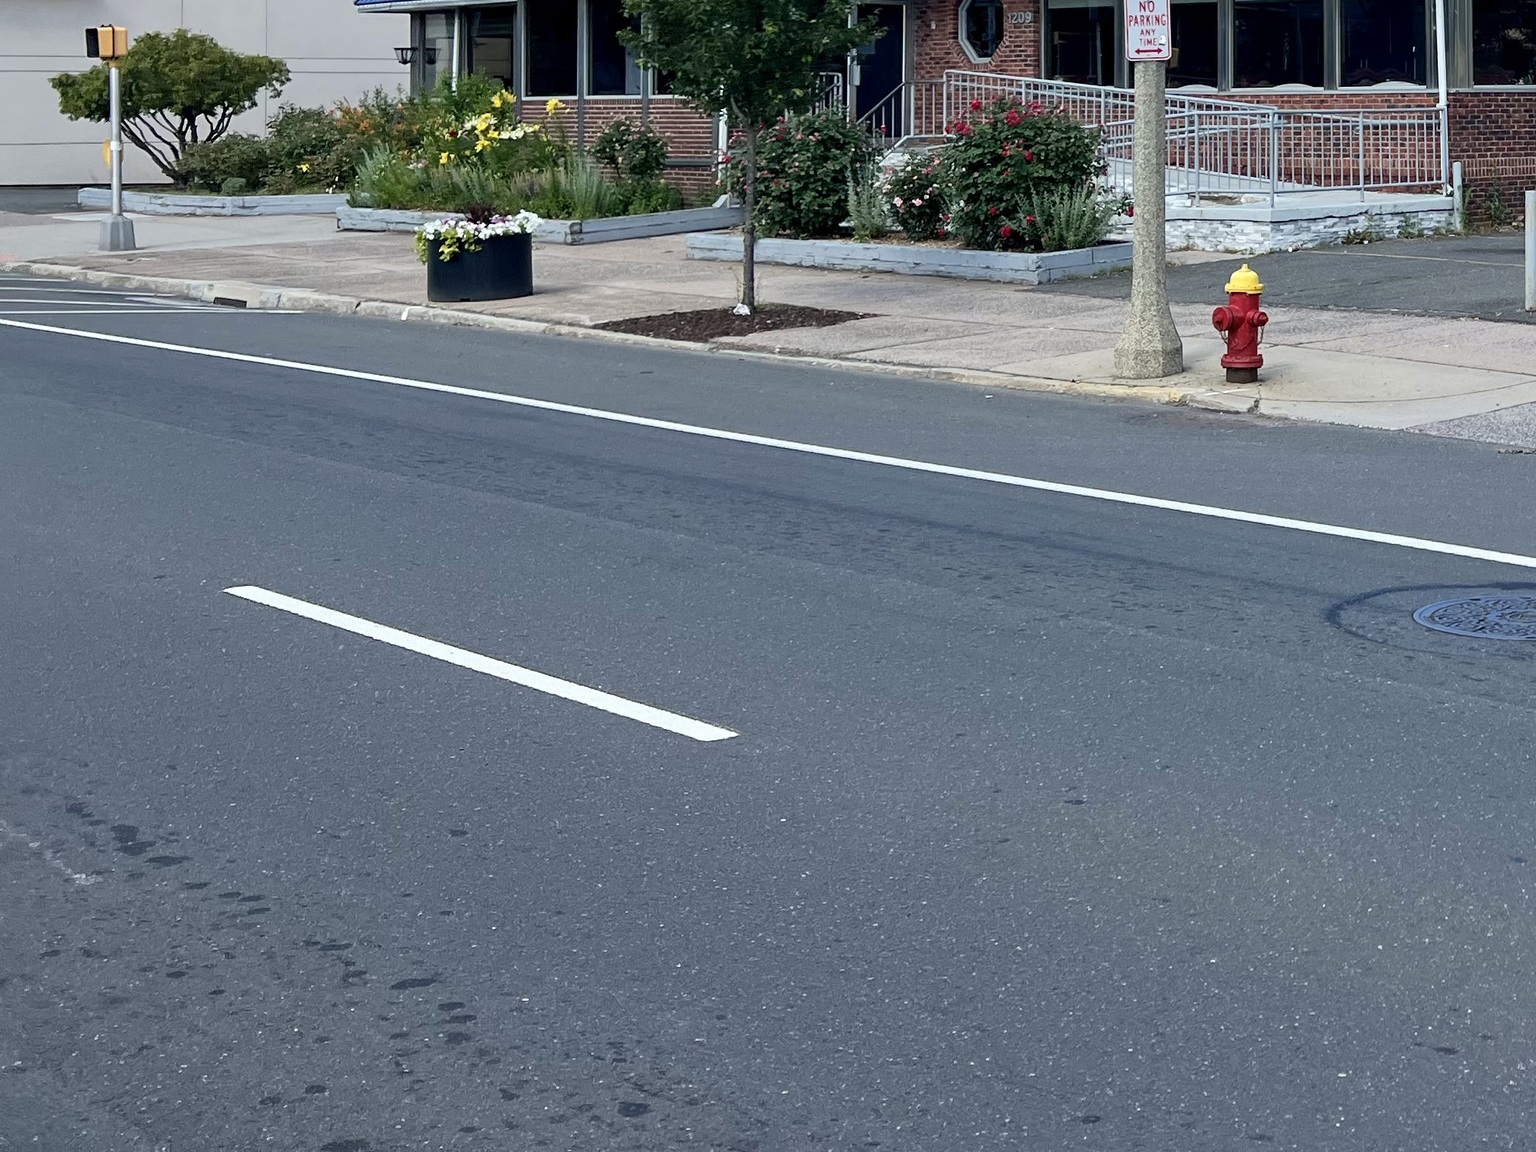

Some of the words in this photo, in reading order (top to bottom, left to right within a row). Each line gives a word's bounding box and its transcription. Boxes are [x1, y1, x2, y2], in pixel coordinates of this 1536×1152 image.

[1139, 0, 1155, 13] NO
[1007, 11, 1033, 24] 1209
[1128, 14, 1166, 27] PARKING
[1139, 38, 1157, 46] TIME
